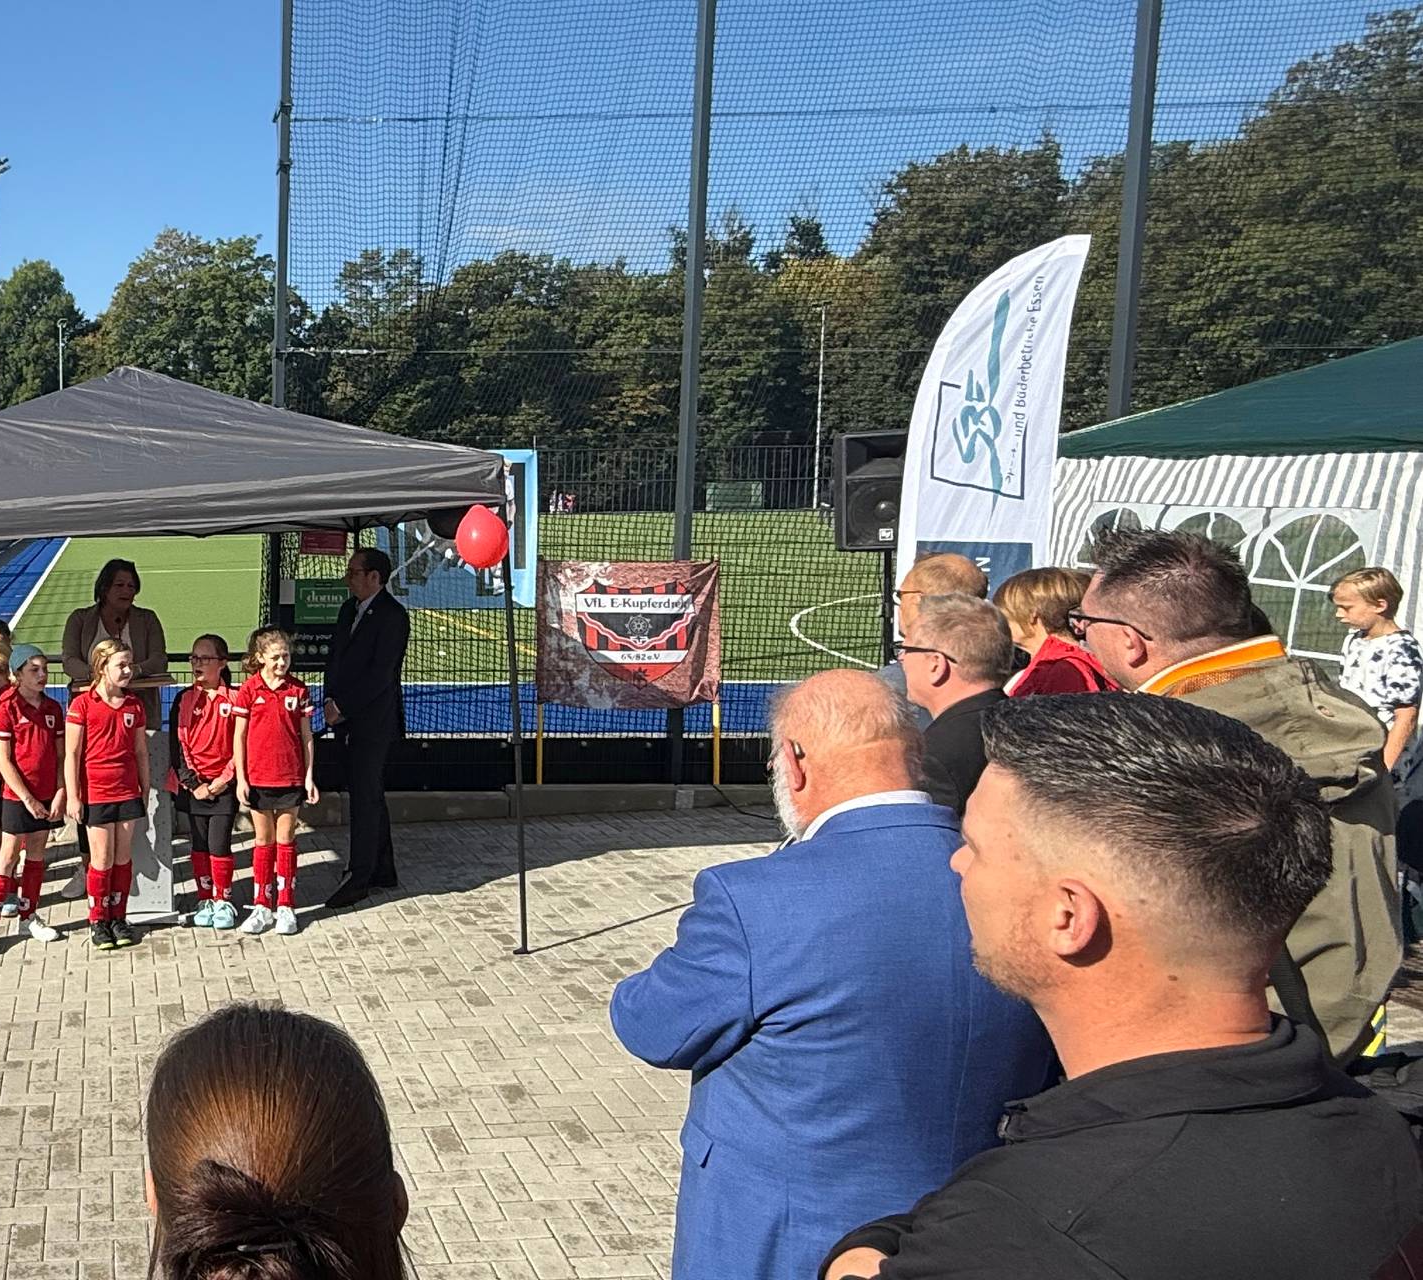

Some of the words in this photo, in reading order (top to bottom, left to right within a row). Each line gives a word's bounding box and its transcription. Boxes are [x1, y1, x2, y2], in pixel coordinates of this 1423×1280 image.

[1013, 411, 1026, 437] und
[1027, 276, 1045, 312] Essen
[584, 597, 606, 608] VfL
